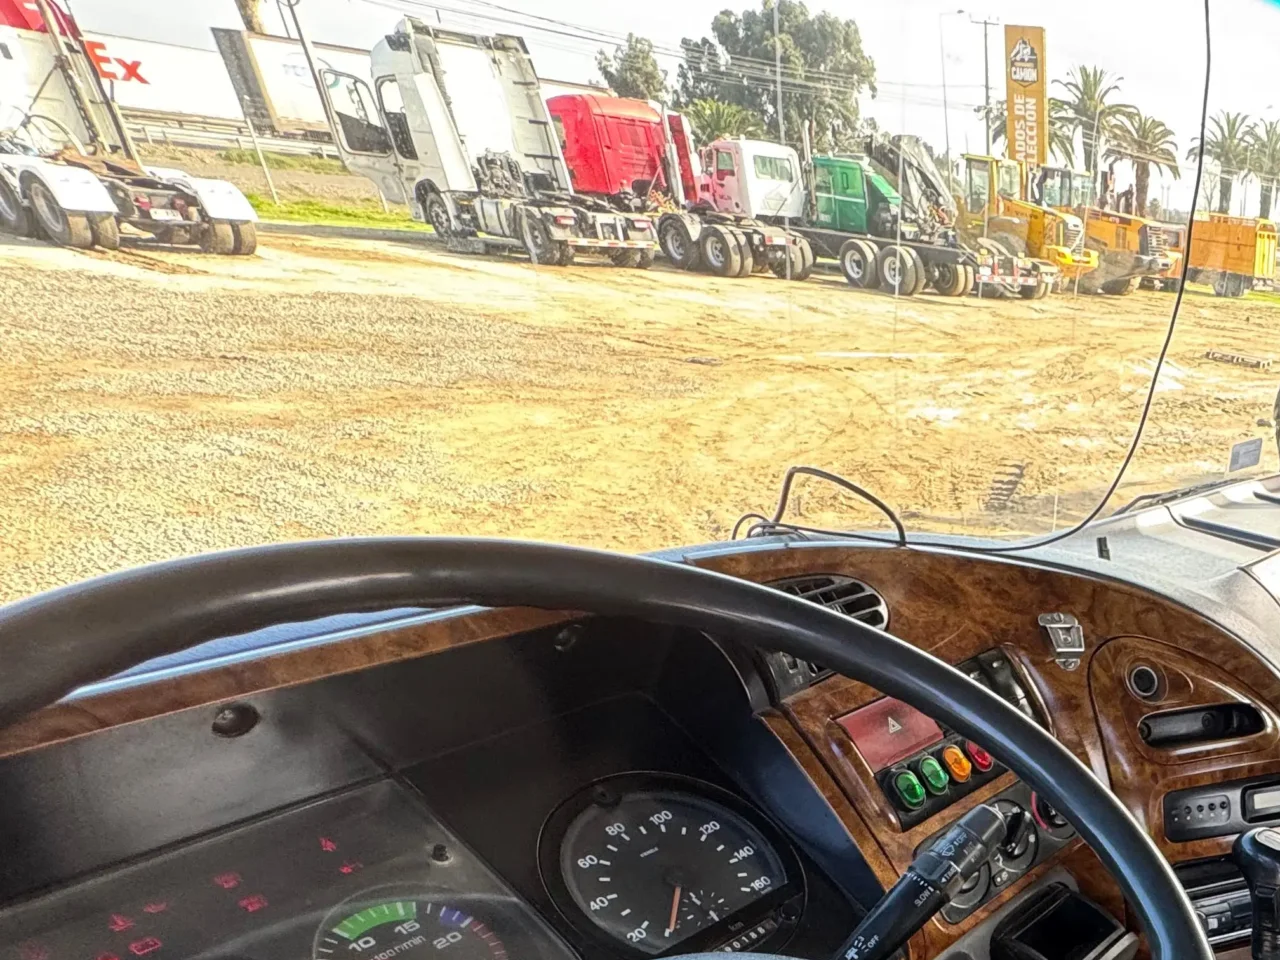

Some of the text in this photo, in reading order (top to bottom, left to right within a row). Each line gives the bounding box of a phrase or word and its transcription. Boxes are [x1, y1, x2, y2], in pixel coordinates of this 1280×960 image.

[85, 40, 150, 85] Ex
[1013, 93, 1025, 115] DE
[649, 810, 672, 825] 100
[605, 822, 625, 836] 80
[699, 821, 720, 836] 120
[735, 846, 753, 860] 140
[577, 854, 598, 869] 60
[750, 876, 770, 891] 160
[589, 896, 609, 912] 40
[914, 889, 931, 907] SLOW
[394, 919, 421, 935] 15
[432, 931, 463, 949] 20
[626, 927, 647, 944] 20
[867, 935, 880, 948] OFF
[348, 936, 376, 952] 10
